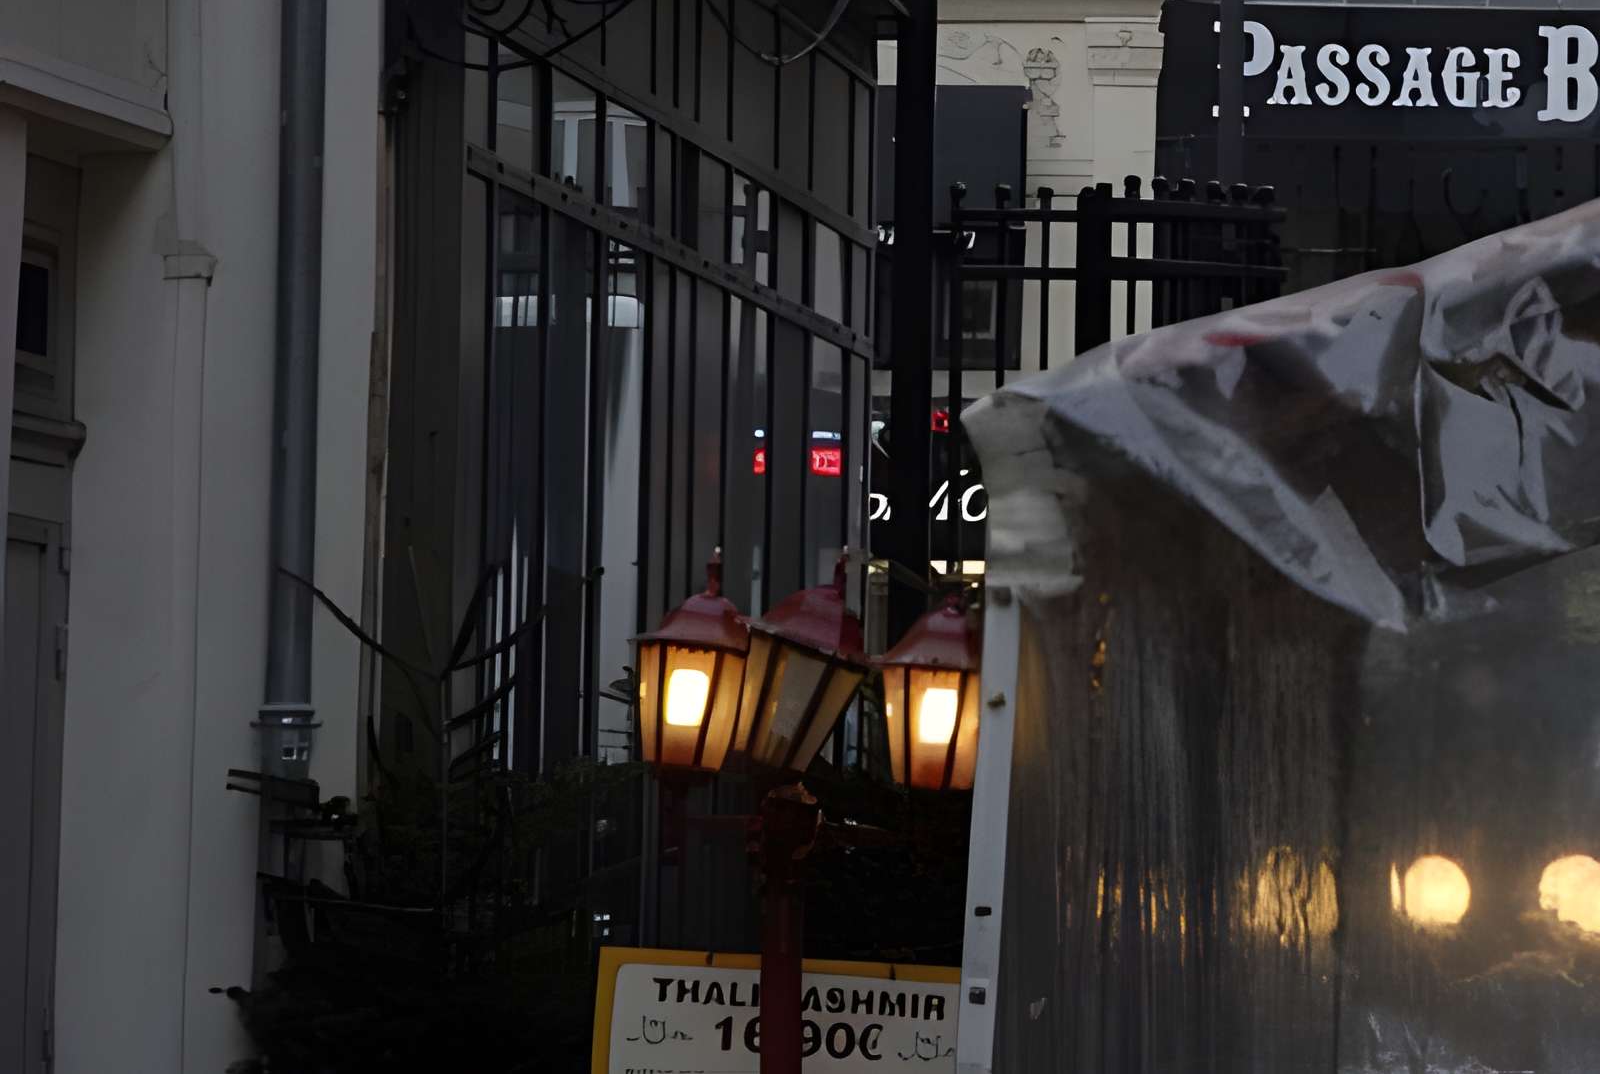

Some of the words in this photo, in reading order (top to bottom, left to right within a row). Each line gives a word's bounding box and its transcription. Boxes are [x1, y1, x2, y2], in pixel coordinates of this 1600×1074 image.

[1212, 20, 1521, 117] PASSAGE
[653, 977, 760, 1007] THALI
[801, 986, 945, 1021] ASHMIR
